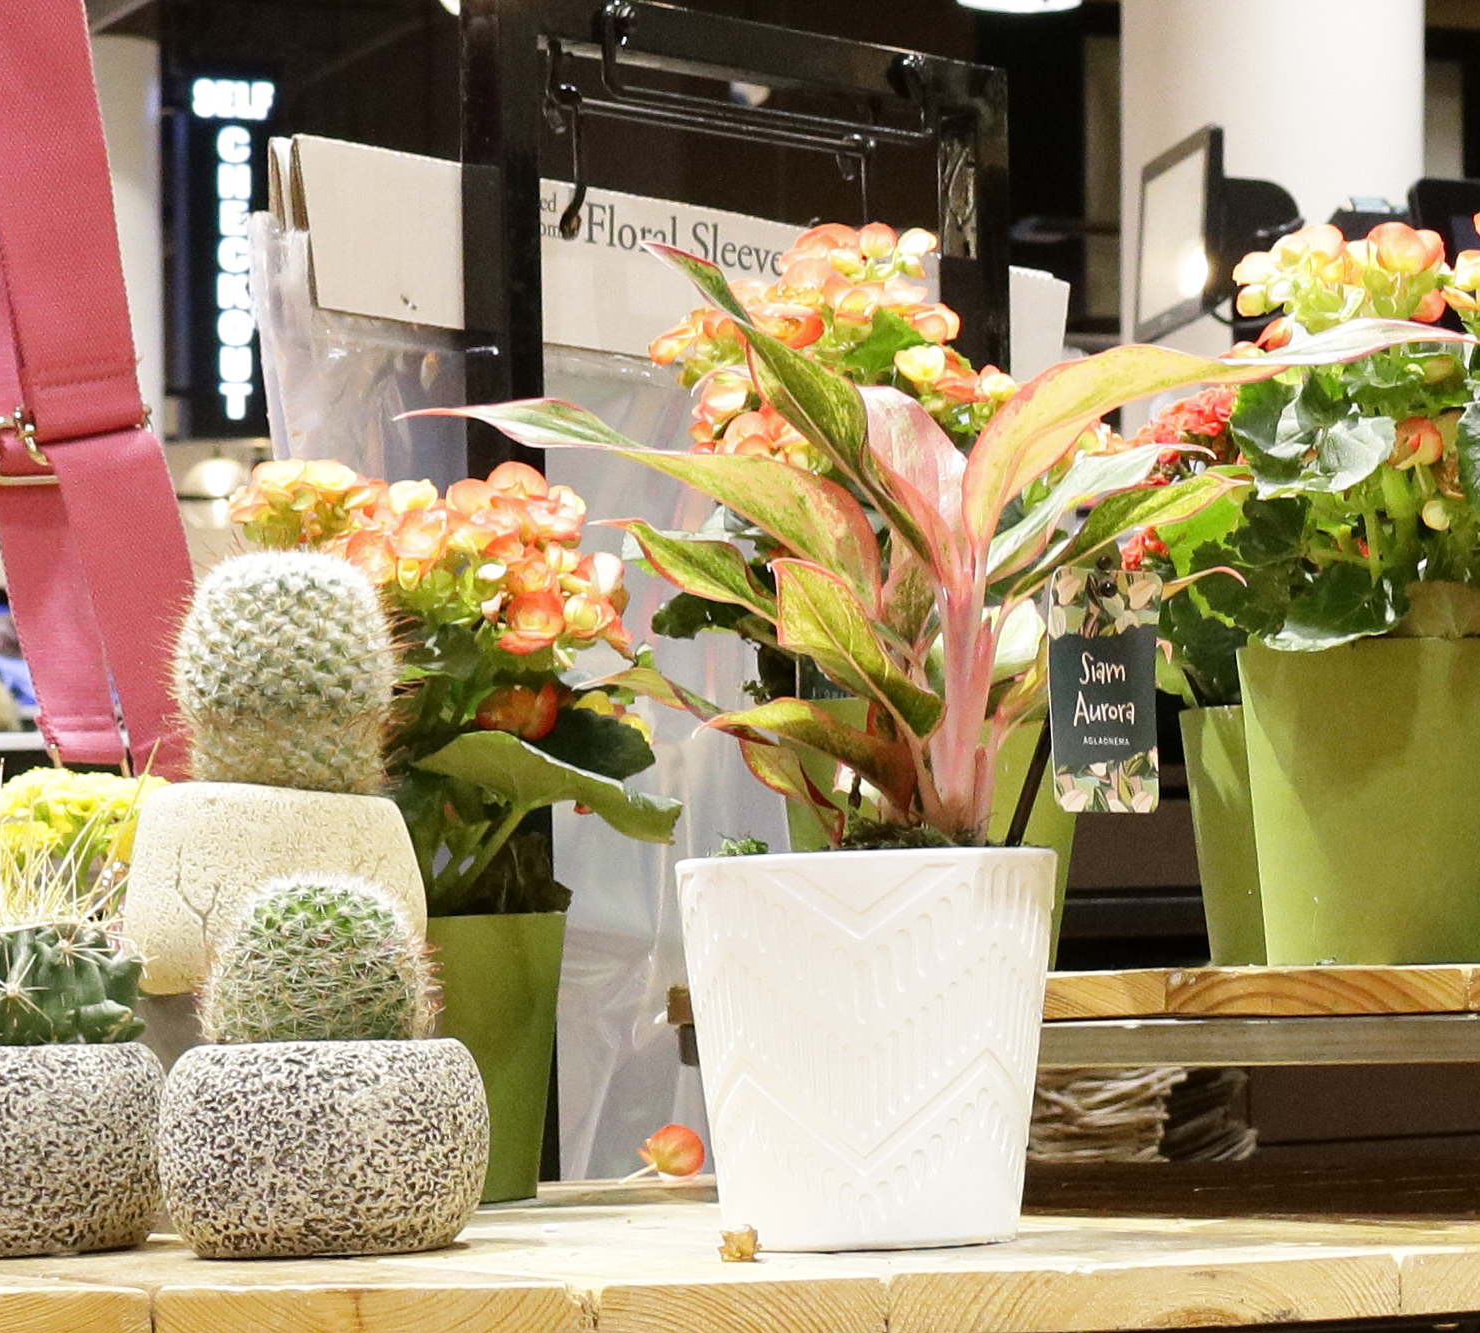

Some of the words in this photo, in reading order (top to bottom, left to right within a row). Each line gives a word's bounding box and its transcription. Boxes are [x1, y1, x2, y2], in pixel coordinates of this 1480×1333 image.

[192, 77, 275, 120] SELF
[584, 201, 678, 254] Floral
[691, 220, 784, 278] Sleeve
[217, 125, 256, 421] CHECKOUT
[1079, 651, 1126, 685] Siam
[1073, 691, 1135, 727] Aurora
